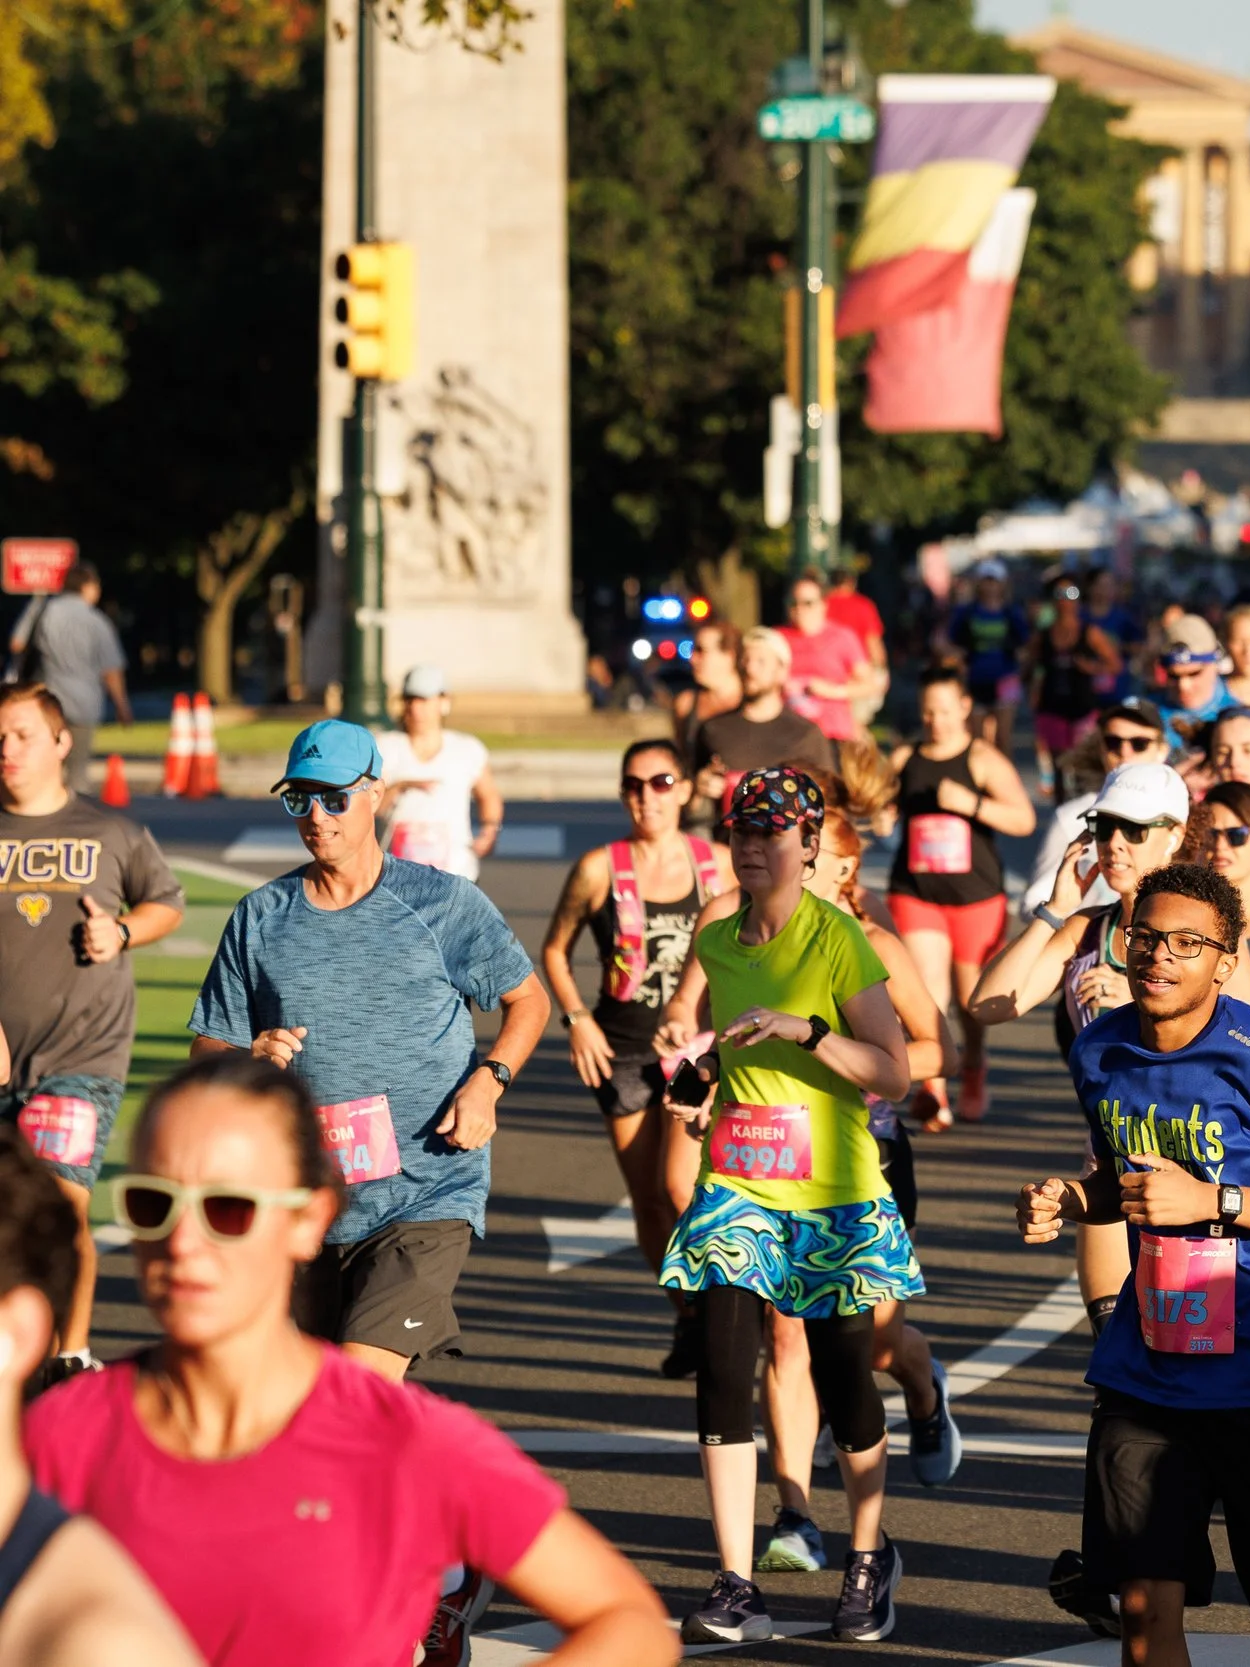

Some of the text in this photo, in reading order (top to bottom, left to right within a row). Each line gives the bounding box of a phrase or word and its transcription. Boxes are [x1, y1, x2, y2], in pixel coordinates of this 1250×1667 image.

[731, 1122, 786, 1141] KAREN
[1098, 1098, 1225, 1163] Students
[722, 1143, 797, 1173] 2994
[1143, 1286, 1208, 1325] 3173
[1189, 1340, 1215, 1352] 3173
